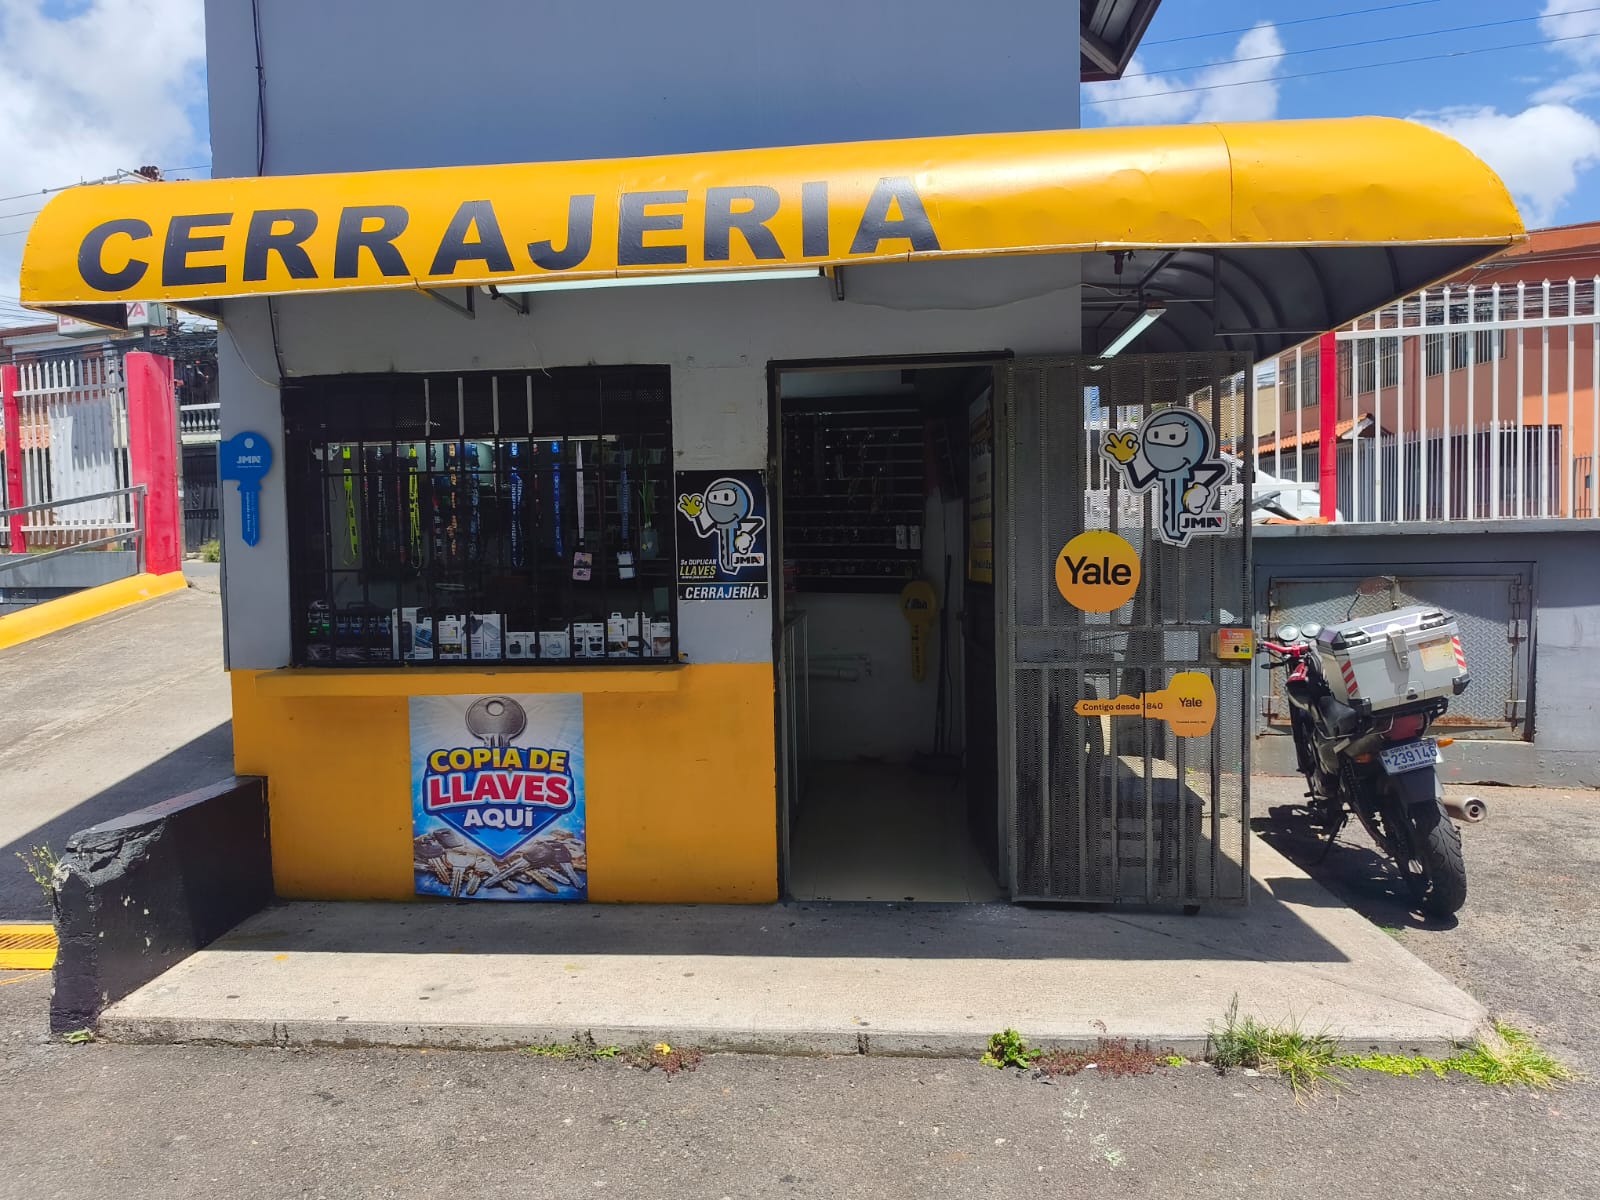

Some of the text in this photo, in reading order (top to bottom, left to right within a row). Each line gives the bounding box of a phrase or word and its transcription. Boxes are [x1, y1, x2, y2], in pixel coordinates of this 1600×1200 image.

[77, 176, 942, 292] CERRAJERIA
[1181, 516, 1221, 529] JMA
[733, 556, 760, 565] JMA
[679, 566, 717, 576] LLAVES
[1063, 555, 1132, 586] Yale
[685, 583, 760, 599] CERRAJERÍA
[1082, 703, 1114, 712] Contigo
[1115, 702, 1140, 711] desde
[1178, 697, 1202, 708] Yale
[430, 749, 566, 772] COPIA DE
[1391, 745, 1438, 767] 239146
[429, 774, 569, 807] LLAVES
[463, 807, 535, 829] AQUÍ
